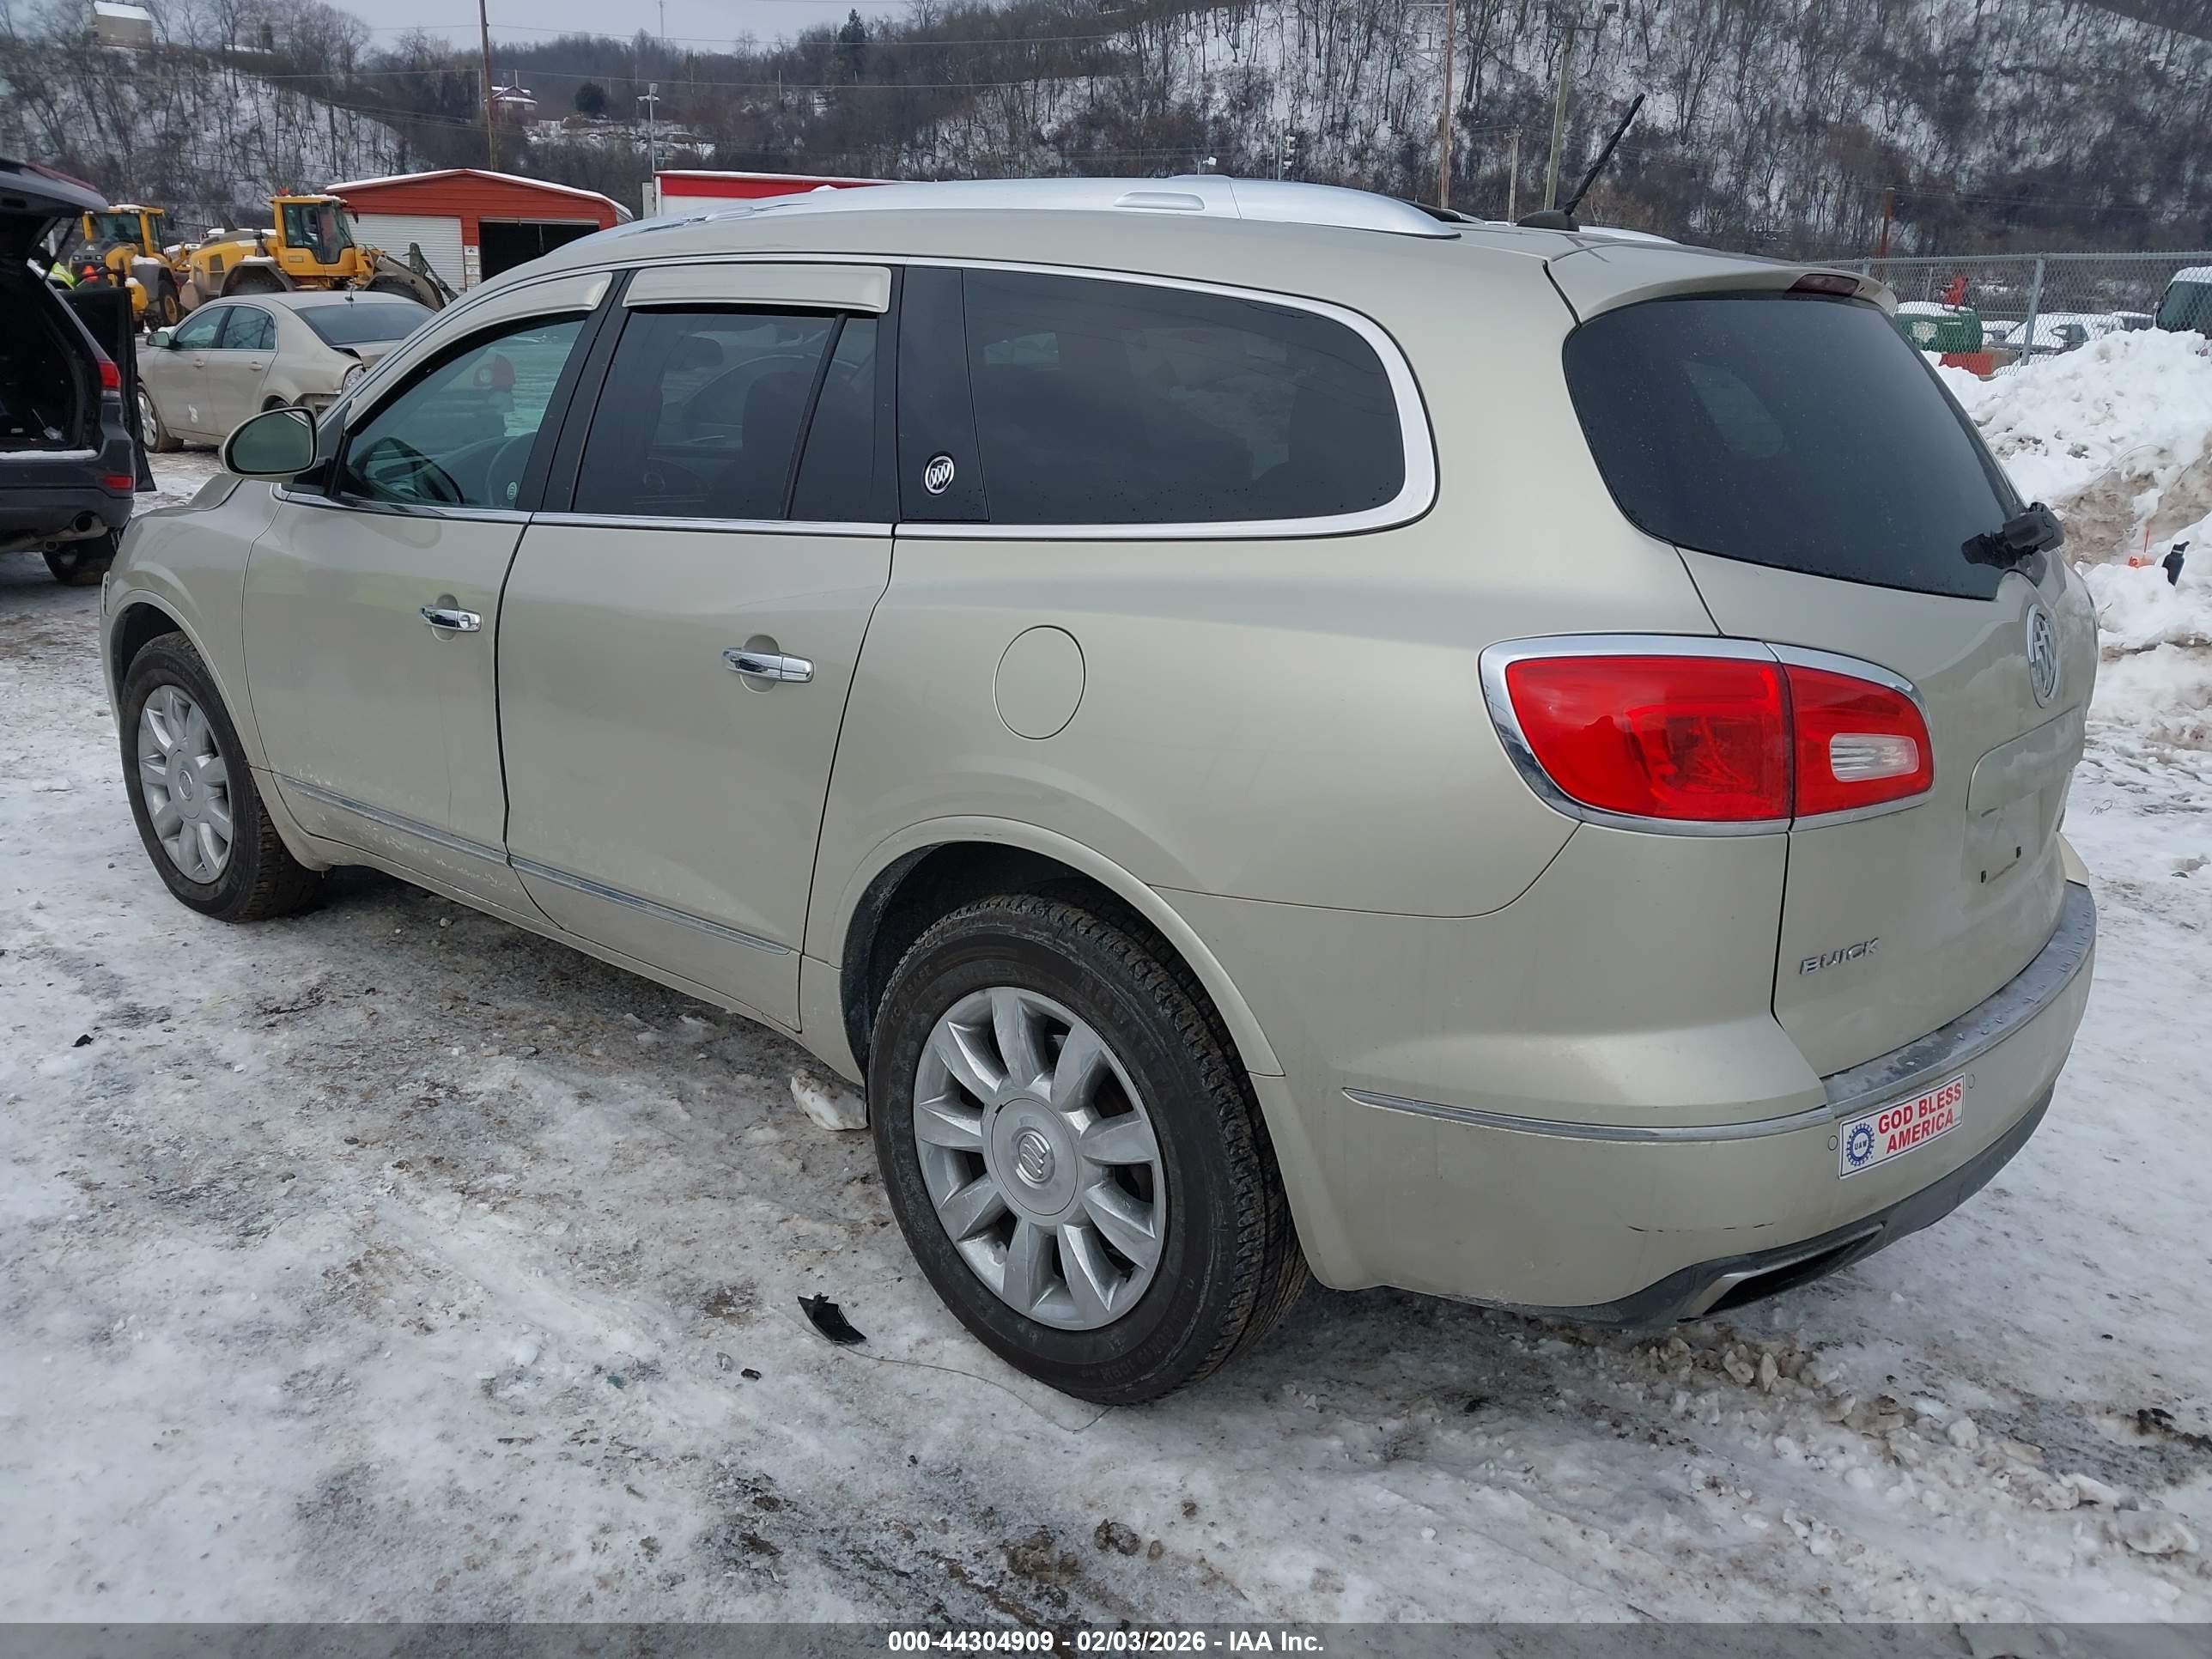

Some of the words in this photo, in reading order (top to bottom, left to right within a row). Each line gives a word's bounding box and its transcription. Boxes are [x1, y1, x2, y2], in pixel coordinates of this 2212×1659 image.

[1799, 937, 1879, 975] BUICK
[1878, 1105, 1913, 1134] GOD
[1918, 1082, 1962, 1119] BLESS
[1854, 1139, 1868, 1151] UAW
[1886, 1109, 1954, 1154] AMERICA
